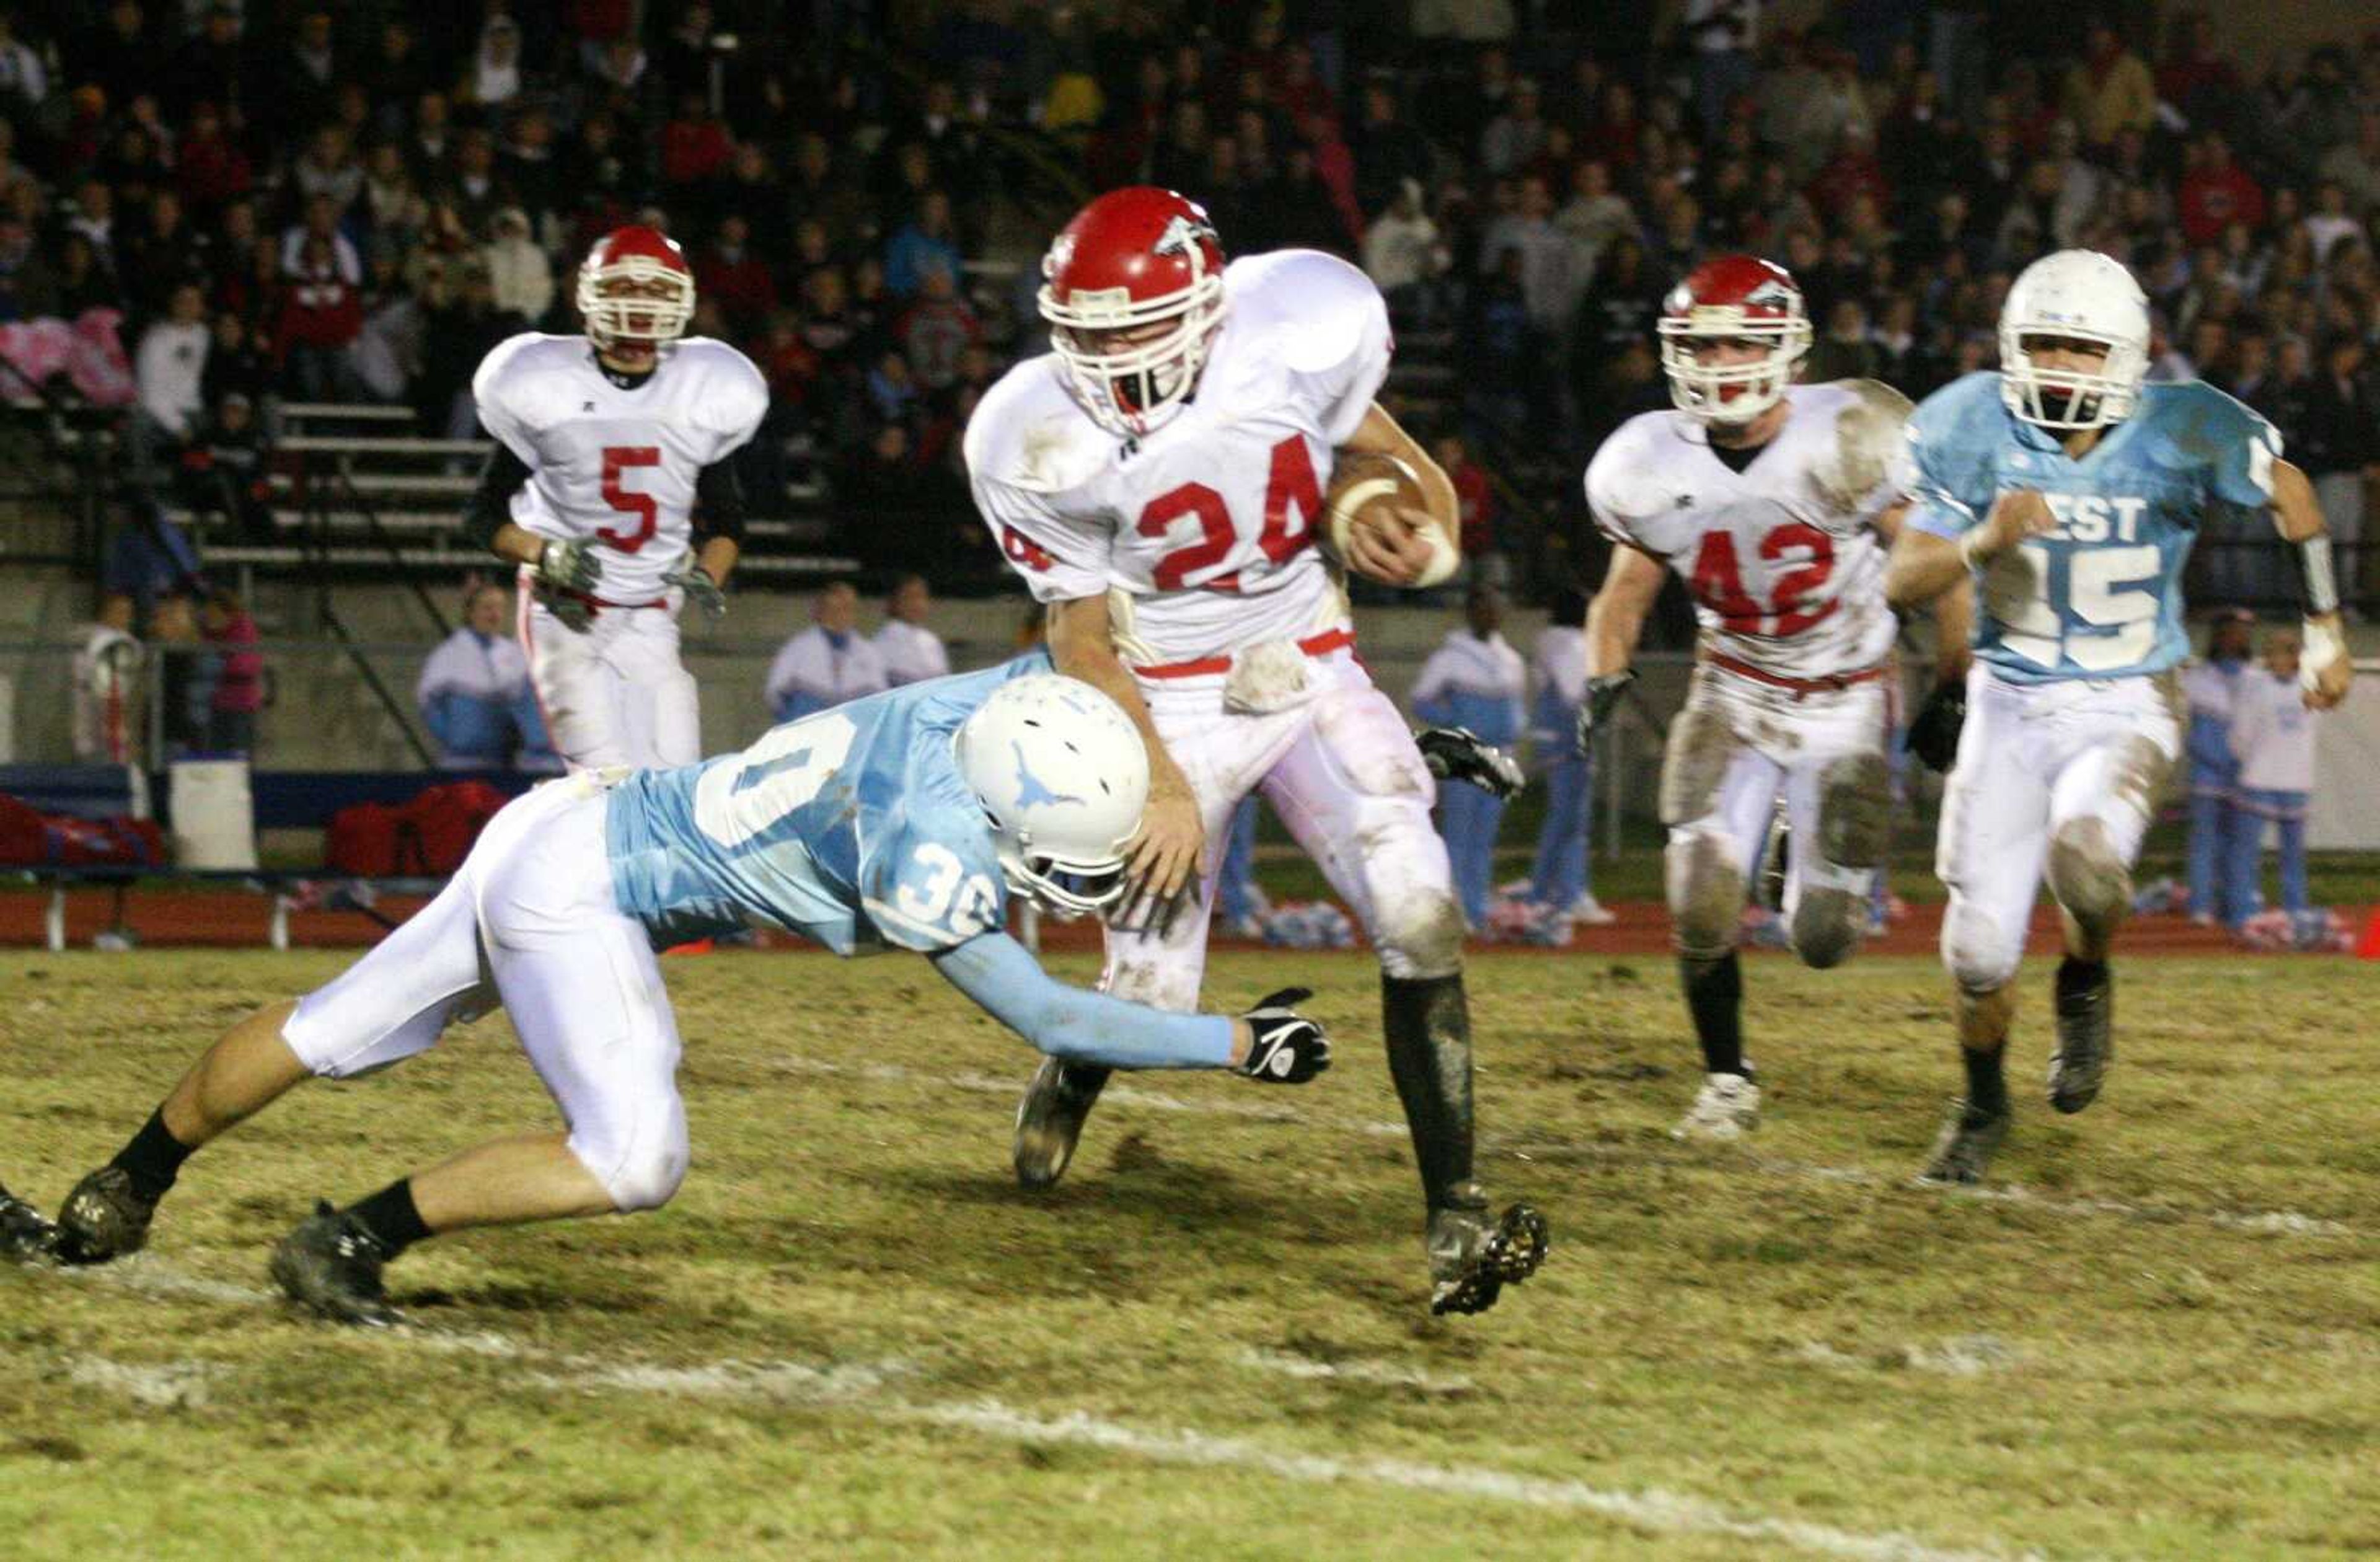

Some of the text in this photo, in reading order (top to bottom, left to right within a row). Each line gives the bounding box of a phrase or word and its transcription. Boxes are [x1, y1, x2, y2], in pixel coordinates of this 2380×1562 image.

[596, 446, 661, 554] 5
[1136, 432, 1322, 593] 24
[1996, 487, 2148, 543] EST
[1690, 523, 1841, 637] 42
[1997, 545, 2162, 671] 15
